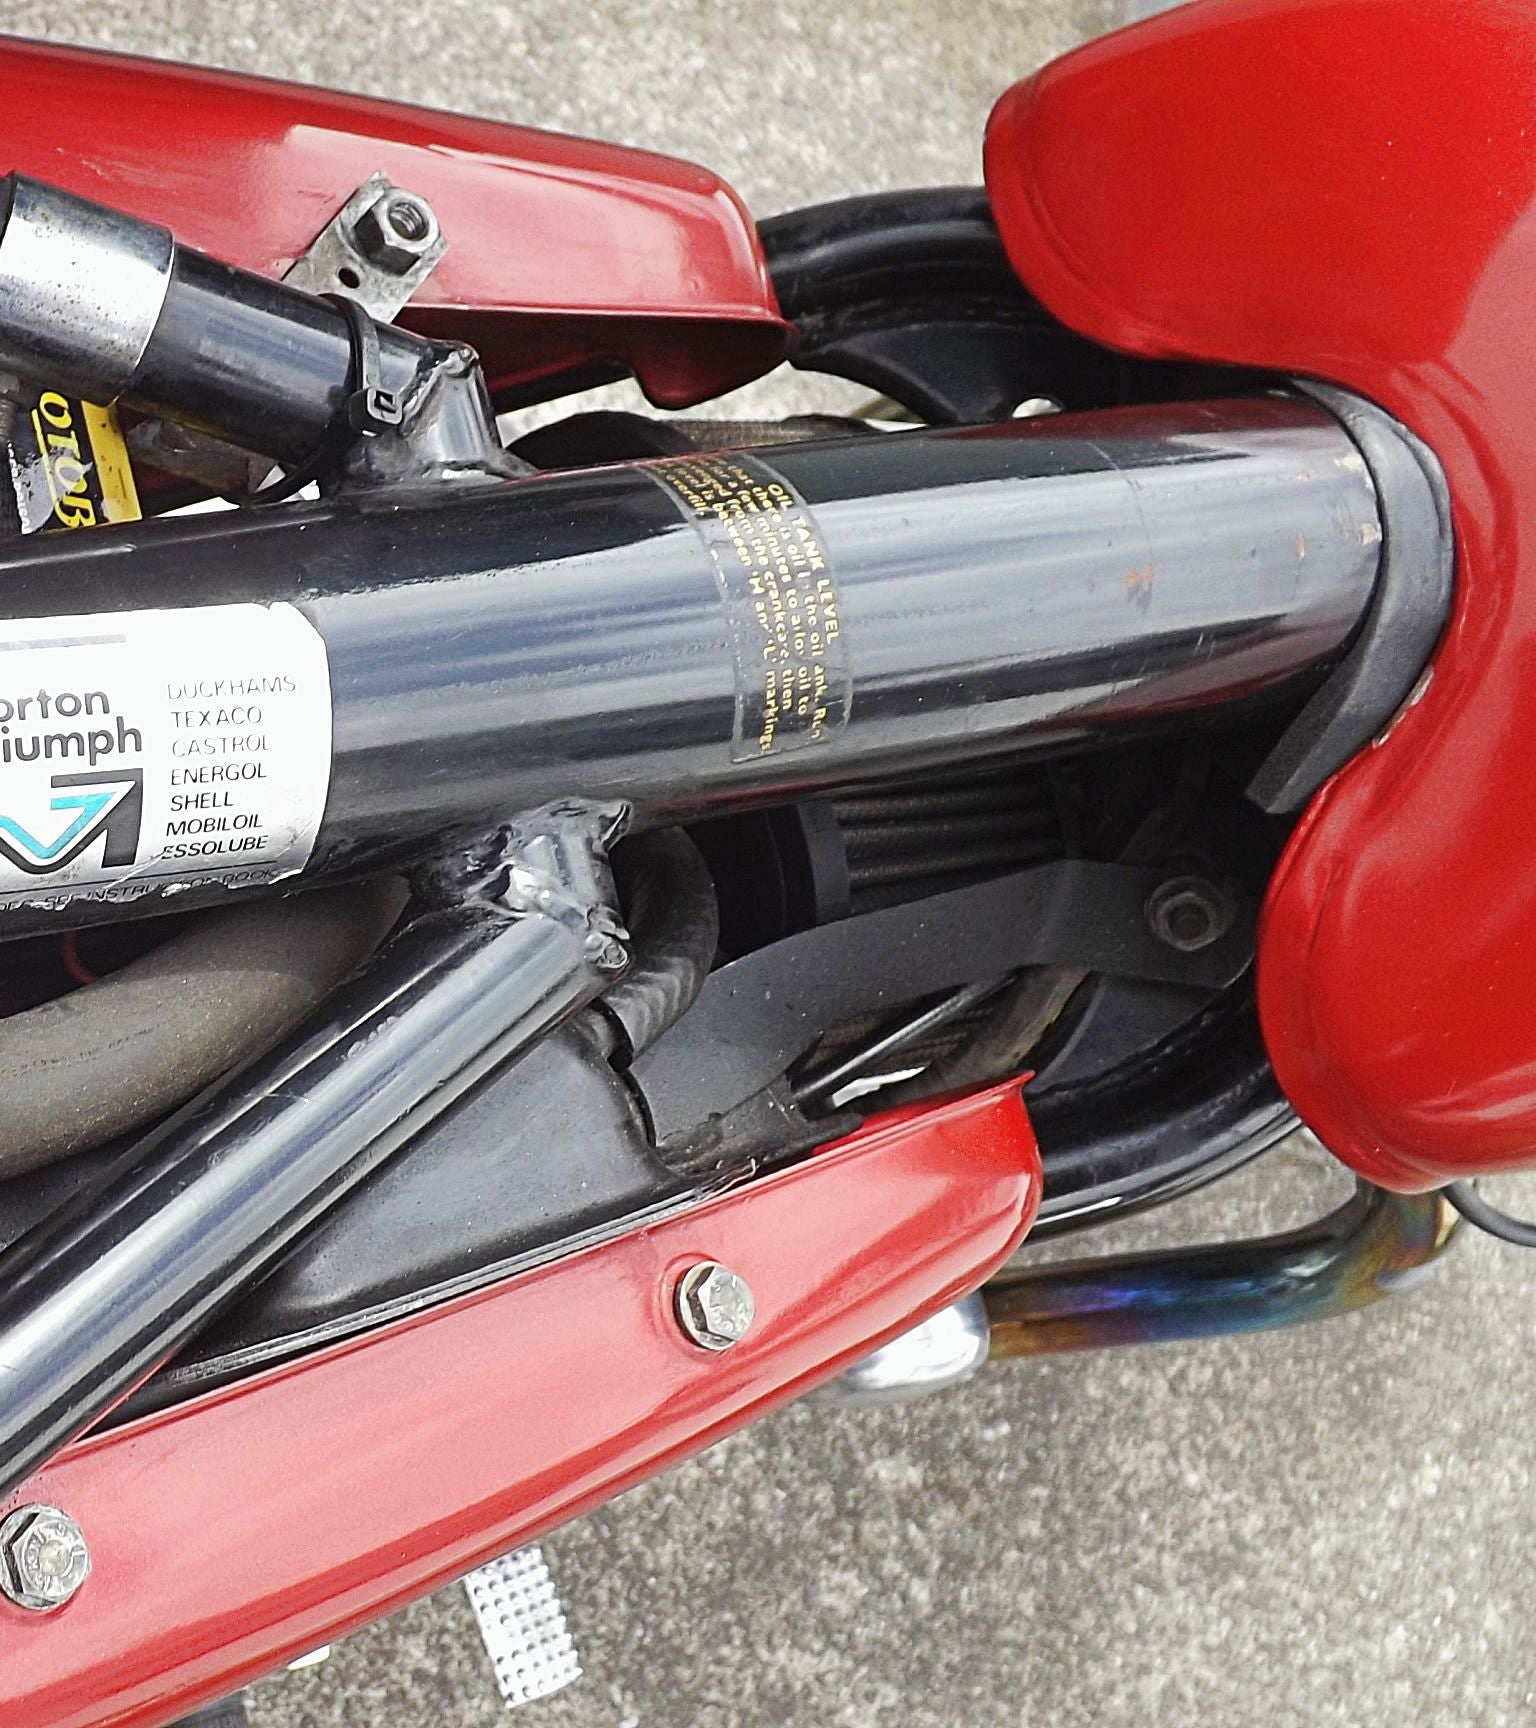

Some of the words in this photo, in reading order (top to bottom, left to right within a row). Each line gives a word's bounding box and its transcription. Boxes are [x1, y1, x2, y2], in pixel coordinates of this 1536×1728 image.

[712, 502, 752, 567] between
[757, 516, 791, 583] minutes
[752, 487, 782, 522] there
[779, 526, 792, 540] is
[788, 544, 806, 566] oil
[810, 631, 825, 657] oil
[768, 483, 794, 511] OIL
[792, 516, 824, 570] TANK
[817, 579, 839, 644] LEVEL
[786, 588, 798, 608] to
[751, 538, 768, 566] the
[782, 668, 795, 710] then
[167, 675, 296, 700] DUCKHAMS
[798, 666, 811, 691] oil
[170, 706, 262, 728] TEXACO
[798, 696, 810, 715] to
[172, 734, 270, 758] CASTROL
[171, 762, 268, 787] ENERGOL
[170, 791, 234, 812] SHELL
[165, 814, 264, 837] MOBILOIL
[161, 835, 269, 860] ESSOLUBE
